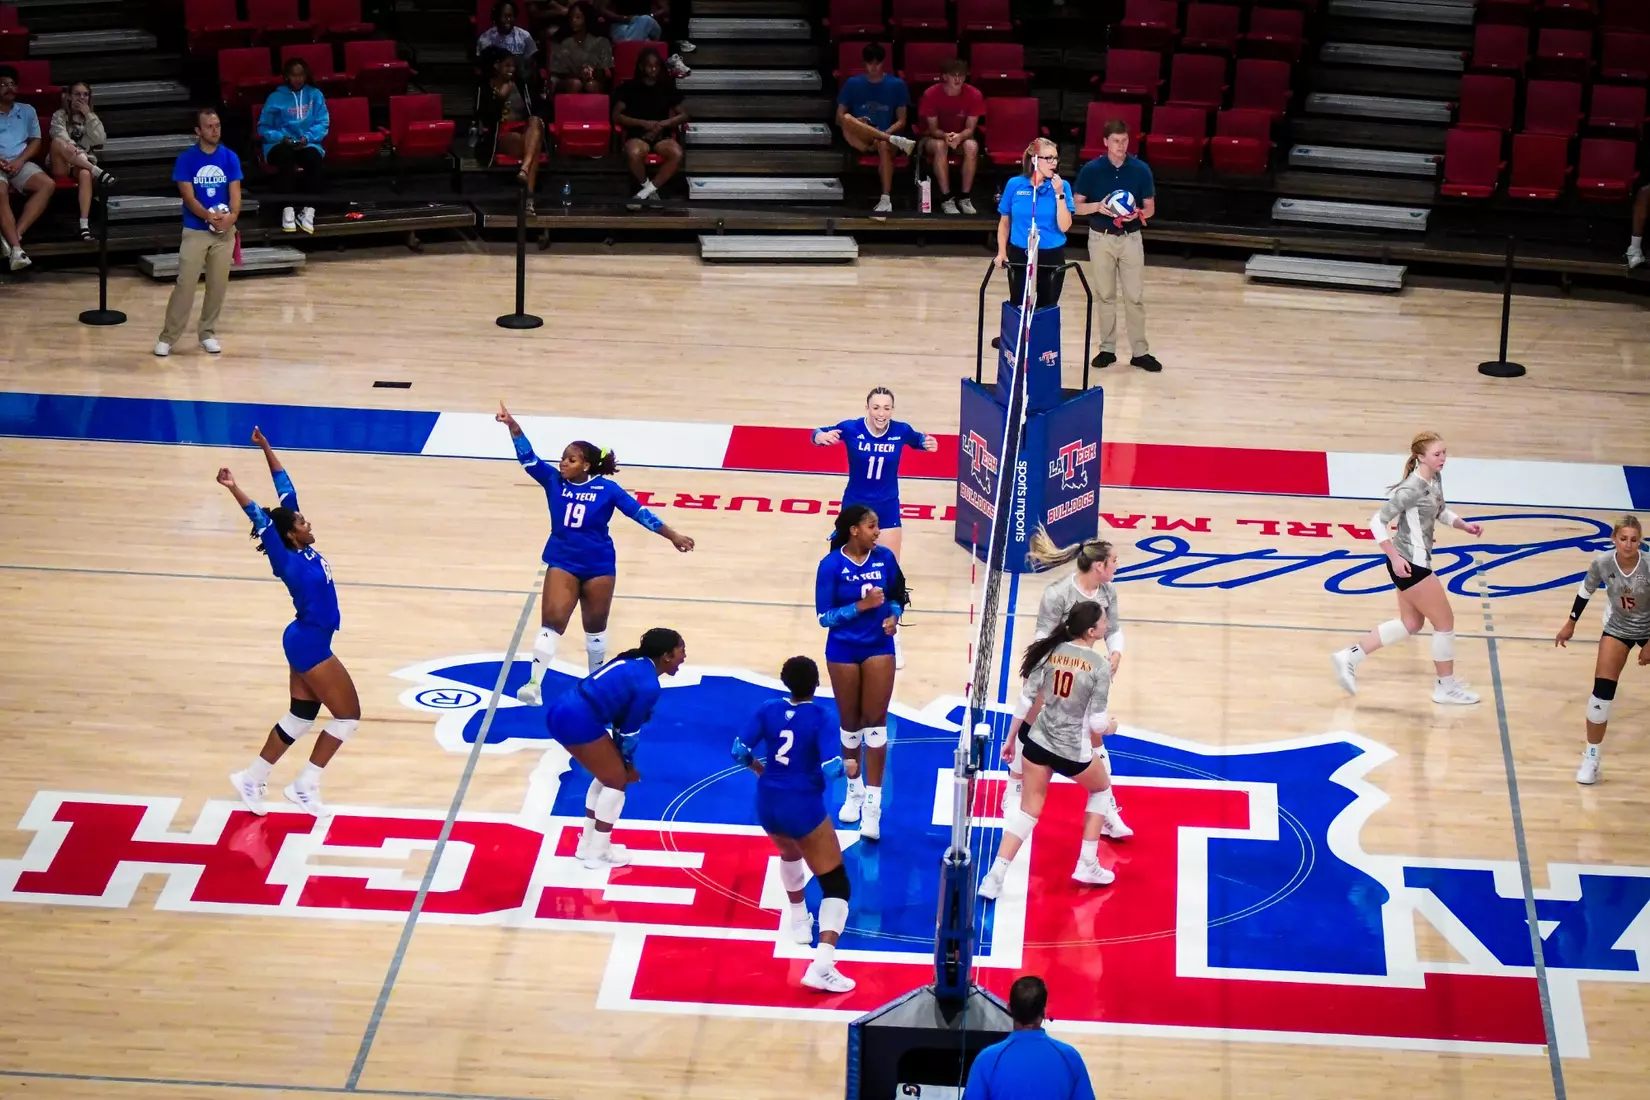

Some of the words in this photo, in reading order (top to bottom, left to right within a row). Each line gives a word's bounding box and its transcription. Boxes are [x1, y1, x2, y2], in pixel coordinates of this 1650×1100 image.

[193, 176, 227, 184] BULLDOG
[858, 442, 871, 452] LA
[873, 443, 895, 453] TECH
[1060, 439, 1097, 480] TECH
[867, 456, 884, 480] 11
[1016, 461, 1028, 497] sports
[561, 488, 573, 499] LA
[576, 492, 597, 502] TECH
[960, 482, 996, 520] BULLDOGS
[1047, 490, 1095, 525] BULLDOGS
[563, 502, 586, 528] 19
[1014, 498, 1026, 542] imports
[1236, 518, 1397, 540] ARL
[860, 570, 882, 581] TECH
[1621, 596, 1636, 610] 15
[1049, 655, 1093, 672] ARHAWKS
[1053, 669, 1074, 698] 10
[775, 730, 794, 765] 2
